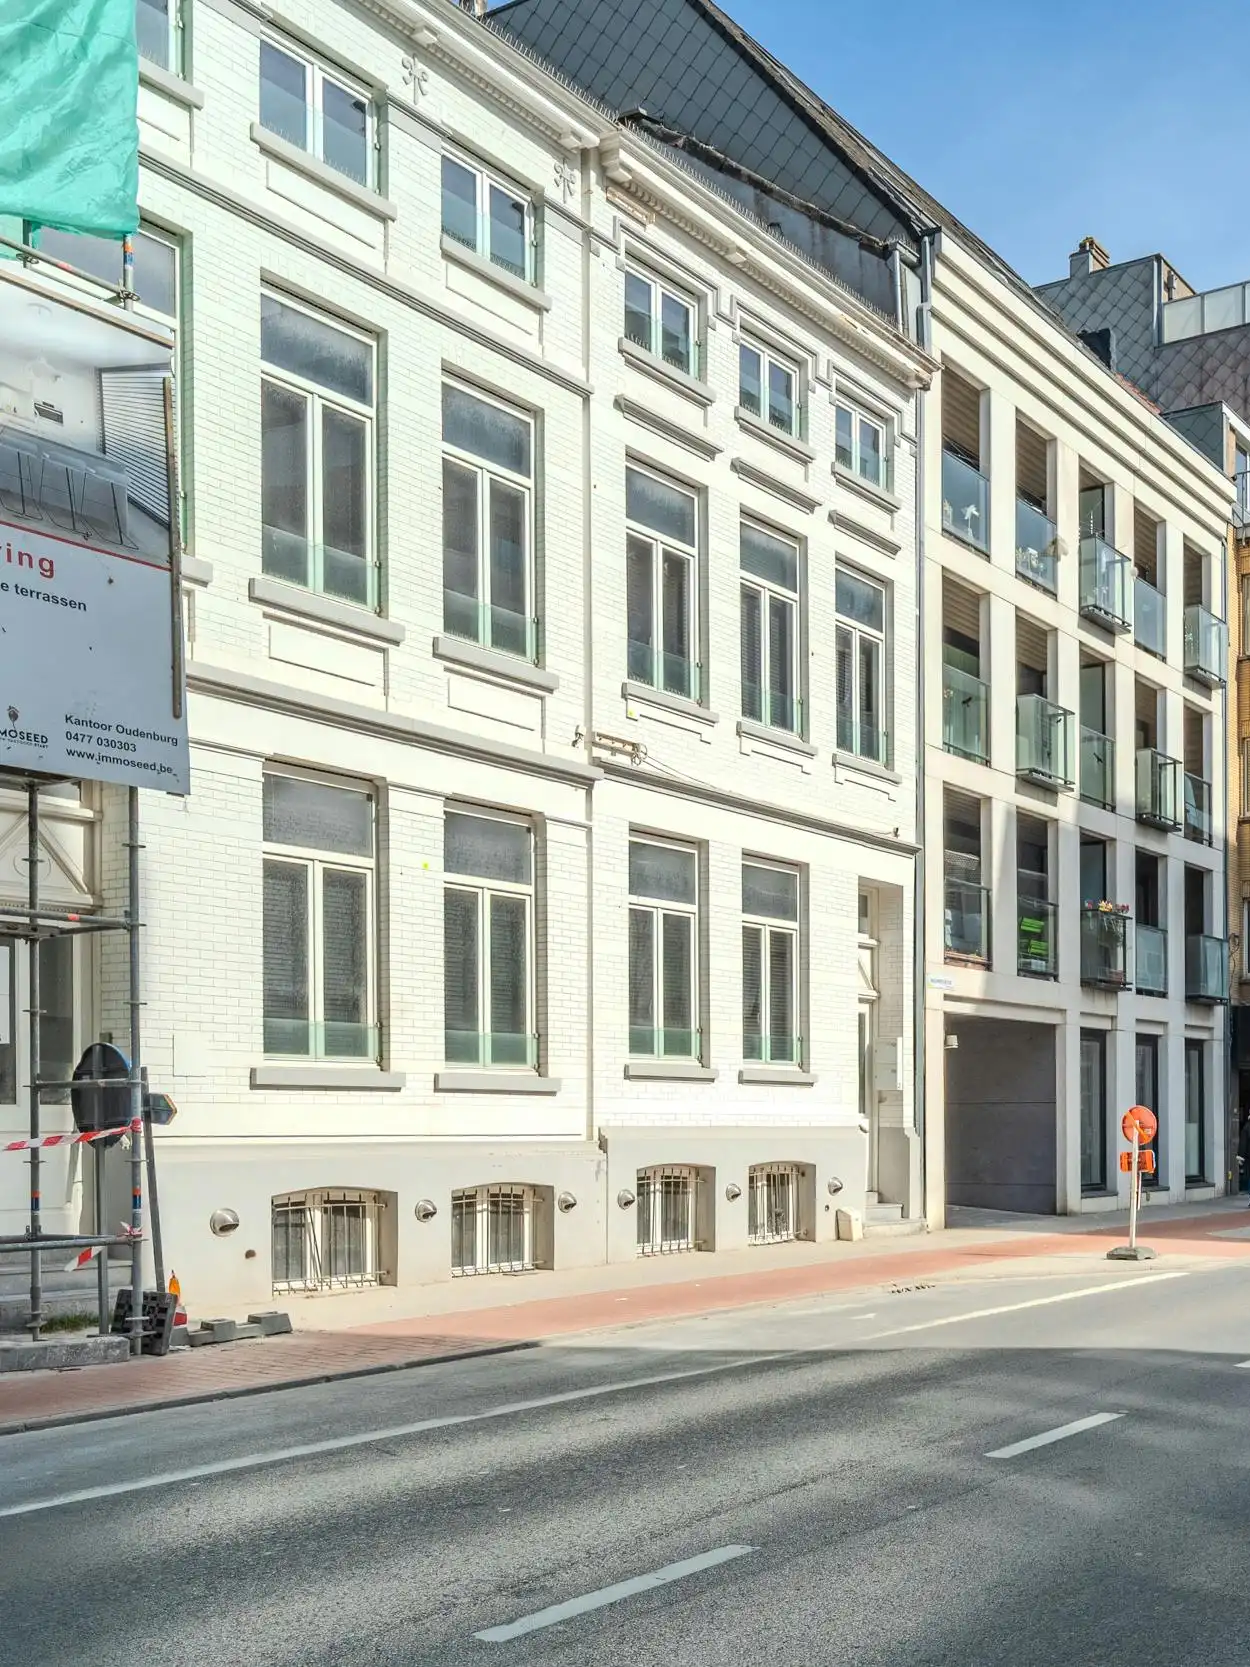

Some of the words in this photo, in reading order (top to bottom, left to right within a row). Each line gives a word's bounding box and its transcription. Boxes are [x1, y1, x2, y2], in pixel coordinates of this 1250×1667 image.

[0, 543, 54, 578] ing
[14, 584, 87, 612] terrassen
[65, 714, 113, 732] Kantoor
[115, 724, 178, 747] Oudenburg
[65, 731, 93, 744] 0477
[96, 736, 137, 752] 030303
[66, 748, 173, 774] www.immoseed.be
